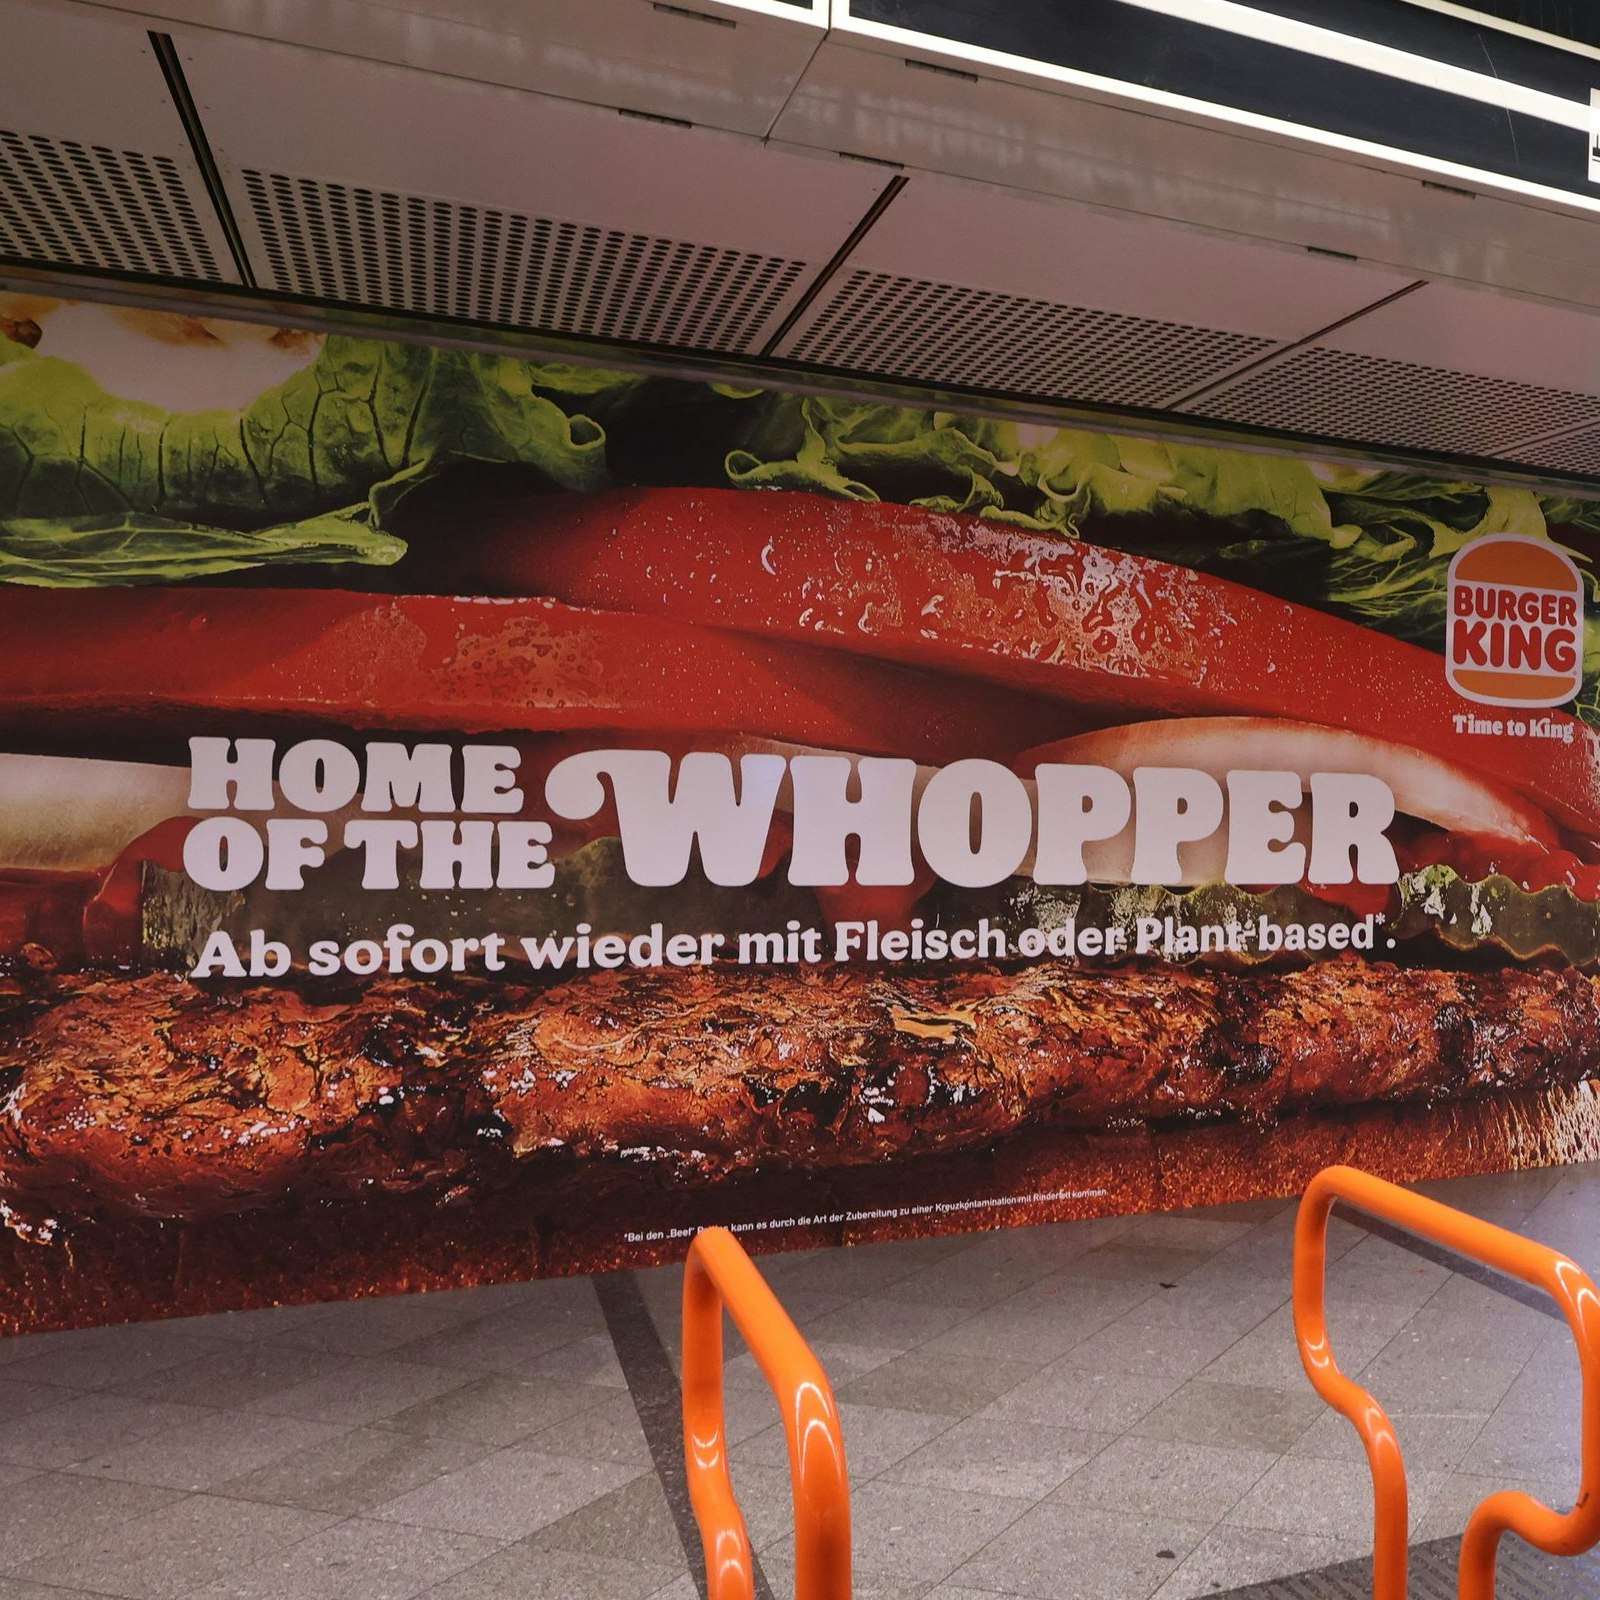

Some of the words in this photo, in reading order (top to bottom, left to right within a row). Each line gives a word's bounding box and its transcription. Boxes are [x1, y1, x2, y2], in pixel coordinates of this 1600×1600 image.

[1454, 585, 1577, 628] BURGER
[1453, 619, 1576, 673] KING
[1453, 714, 1503, 736] Time
[1507, 718, 1527, 737] to
[1529, 716, 1574, 744] King
[188, 736, 525, 814] HOME
[545, 748, 1400, 888] WHOPPER
[183, 816, 328, 891] OF
[344, 819, 555, 889] THE
[191, 929, 292, 978] Ab
[308, 923, 506, 977] sofort
[521, 922, 726, 970] wieder
[738, 920, 822, 963] mit
[834, 917, 1007, 963] Fleisch
[1017, 918, 1125, 960] oder
[646, 1230, 664, 1240] den
[731, 1222, 754, 1233] kann
[756, 1221, 767, 1230] es
[769, 1216, 795, 1228] durch
[798, 1215, 811, 1225] die
[813, 1213, 827, 1224] Art
[829, 1212, 844, 1223] der
[846, 1206, 897, 1221] Zubereitung
[900, 1207, 909, 1216] zu
[912, 1203, 934, 1214] einer
[935, 1195, 1017, 1212] Kreuzkontamination
[1018, 1194, 1031, 1204] mit
